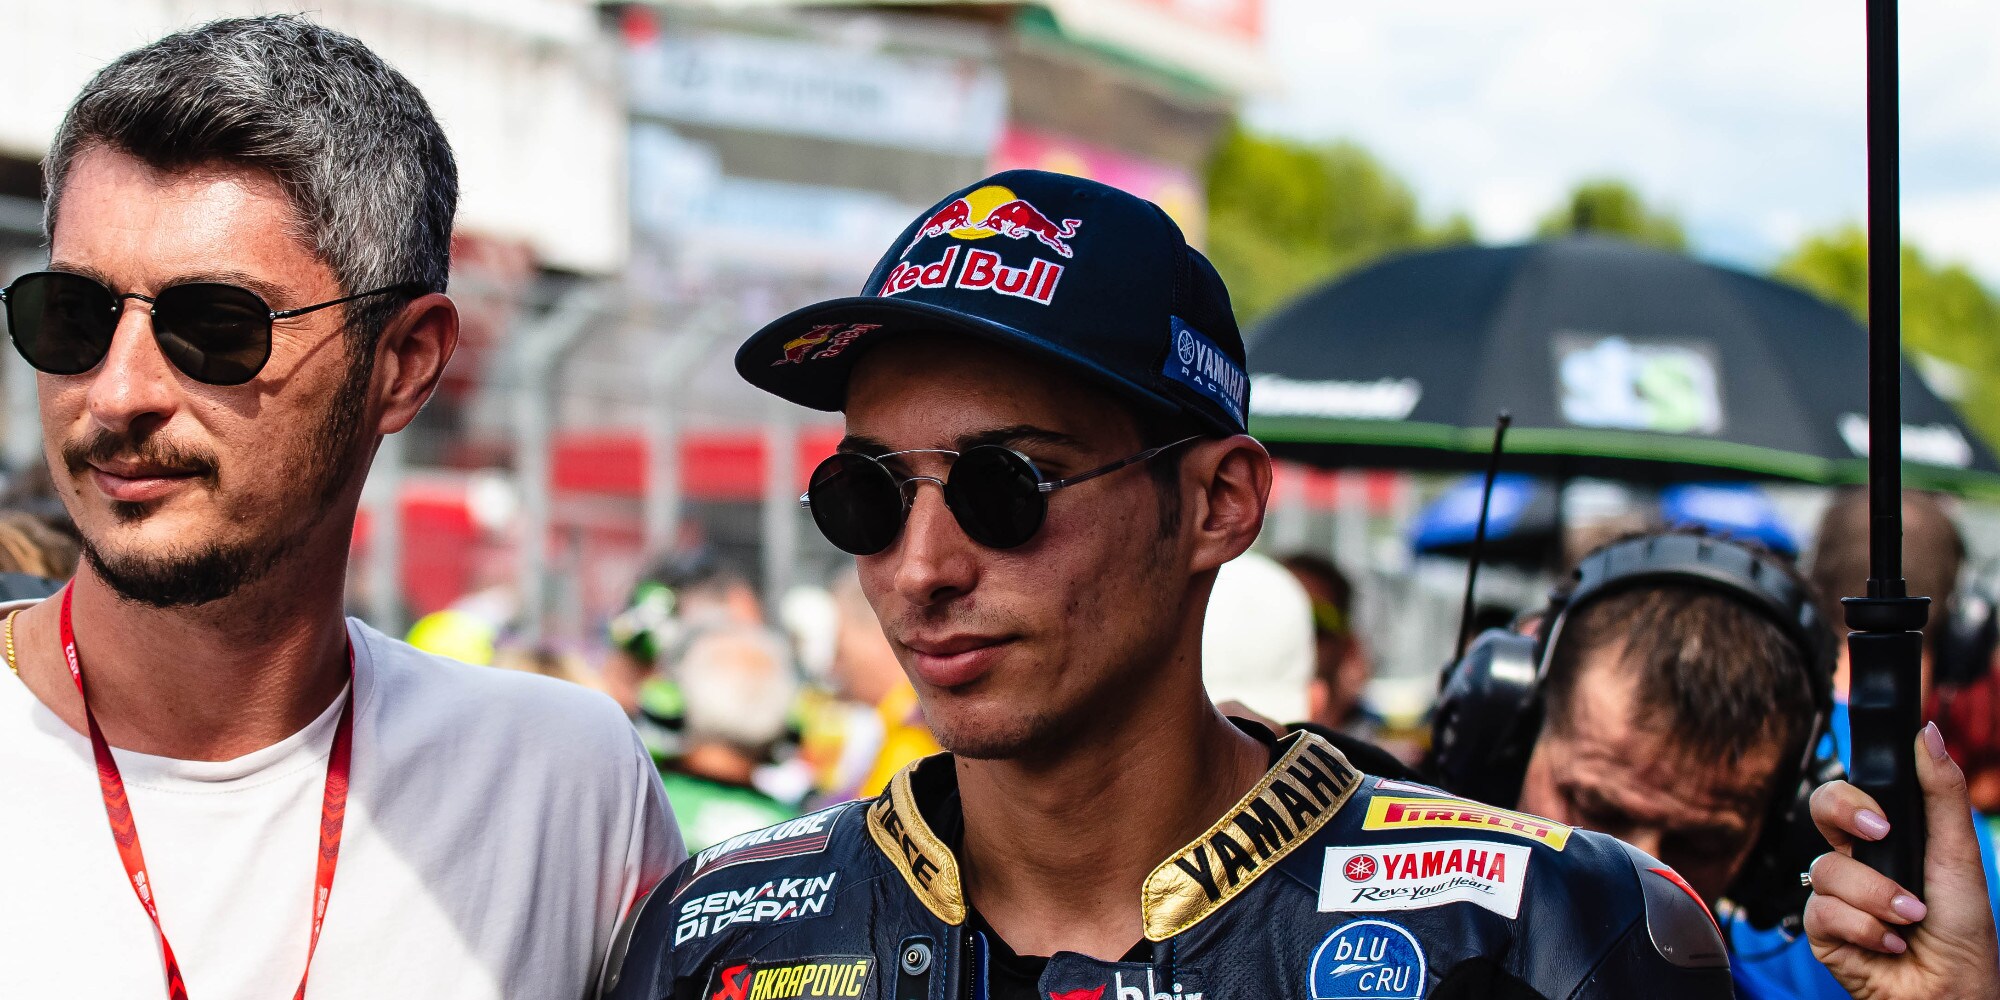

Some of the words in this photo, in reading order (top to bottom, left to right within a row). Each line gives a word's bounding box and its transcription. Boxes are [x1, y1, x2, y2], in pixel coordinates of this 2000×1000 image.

[877, 245, 961, 298] Red
[955, 248, 1065, 306] Bull
[1195, 340, 1245, 407] YAMAHA
[692, 808, 834, 877] YAMALUBE
[1174, 743, 1355, 903] YAMAHA
[1384, 803, 1554, 838] PIRELLI
[1351, 886, 1410, 904] Revs
[1409, 881, 1450, 901] Your
[1449, 876, 1495, 895] Heart
[1383, 848, 1506, 883] YAMAHA
[675, 915, 709, 947] DI
[711, 893, 828, 935] DEPAN
[678, 872, 837, 922] SEMAKIN
[1333, 936, 1389, 962] bLU
[750, 960, 867, 1000] AKRAPOVIČ
